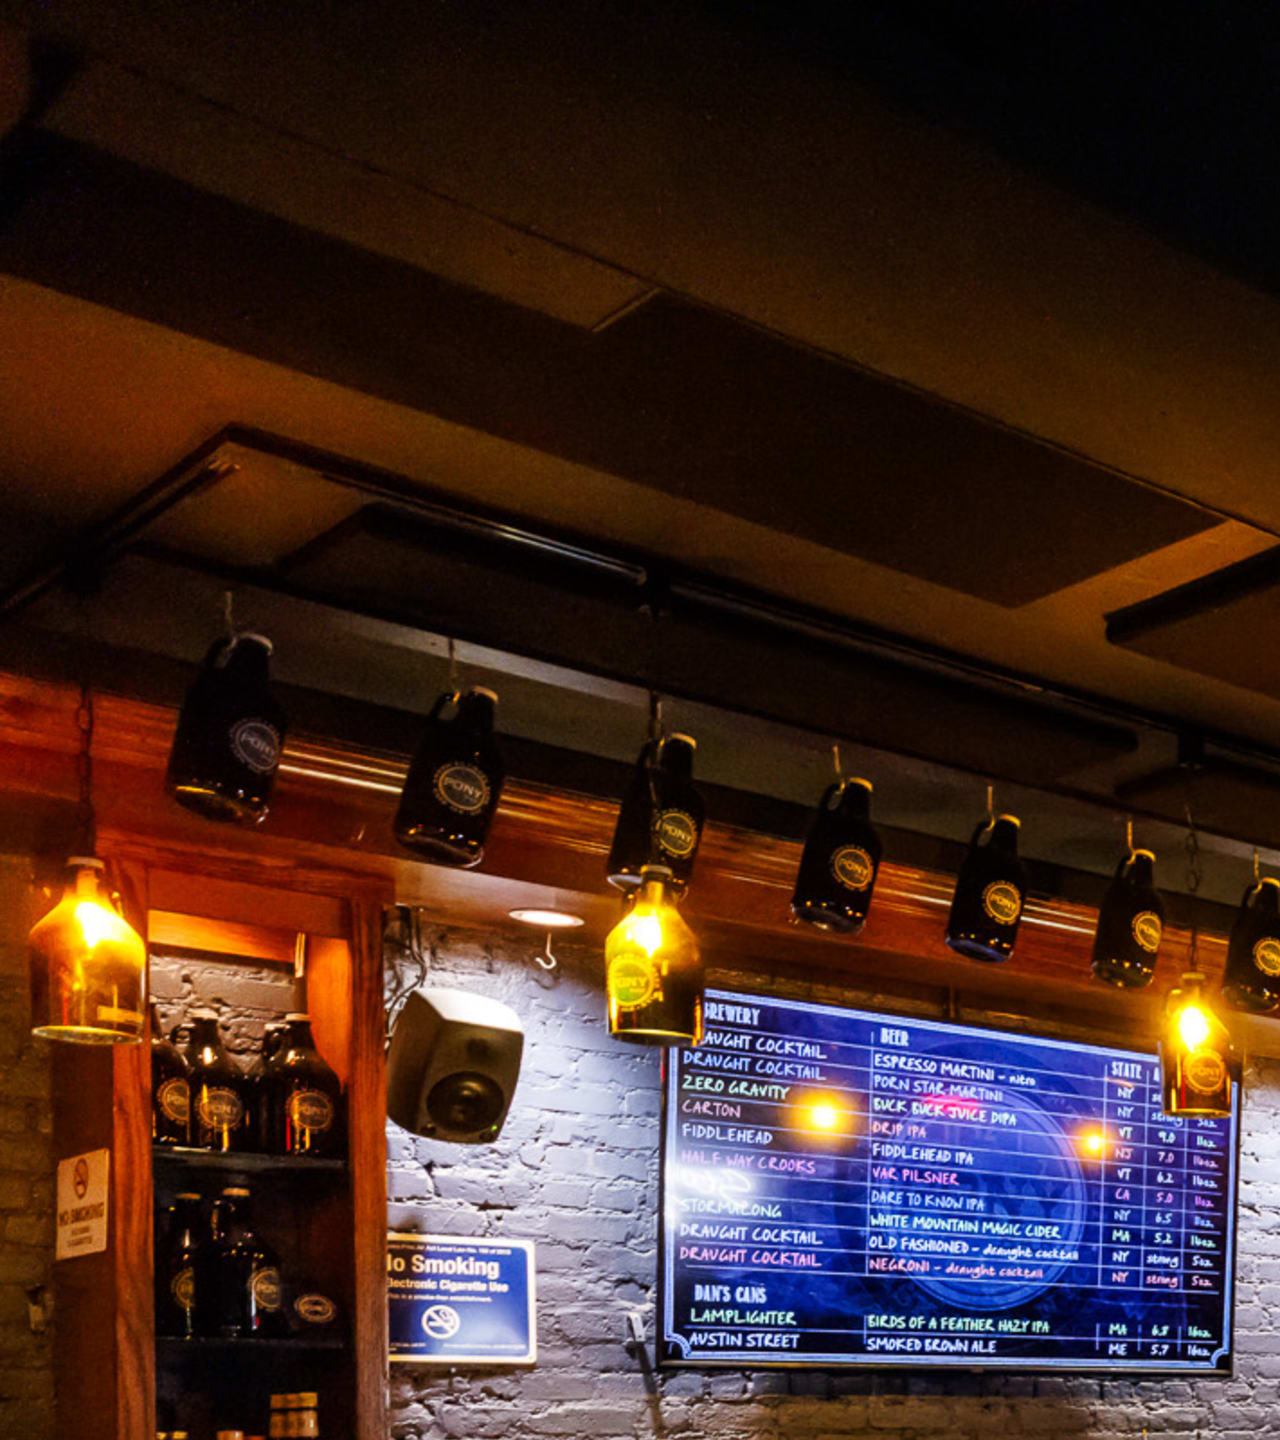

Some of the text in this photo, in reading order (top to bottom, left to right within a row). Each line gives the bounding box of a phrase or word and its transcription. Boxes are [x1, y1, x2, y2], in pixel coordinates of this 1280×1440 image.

[443, 776, 481, 799] PONY
[663, 822, 693, 842] PONY
[838, 857, 869, 877] PONY
[704, 1002, 761, 1026] BREWERY
[703, 1031, 827, 1059] AUGHT COCKTAIL
[880, 1027, 910, 1047] BEER
[683, 1050, 827, 1081] DRAUGHT COCKTAIL
[874, 1053, 937, 1073] ESPRESSO
[941, 1062, 995, 1081] MARTINI
[1112, 1061, 1142, 1080] STATE
[682, 1075, 790, 1100] ZERO GRAVITY
[874, 1075, 1004, 1102] PORN STAR MARTINI
[1117, 1086, 1135, 1100] NY
[682, 1099, 741, 1119] CARTON
[874, 1098, 1016, 1126] BUCK BUCK JUICE DIPA
[1117, 1106, 1135, 1119] NY
[681, 1123, 773, 1145] FIDDLEHEAD
[872, 1121, 927, 1138] DRIP IPA
[1119, 1126, 1133, 1139] VT
[681, 1150, 816, 1174] HALF WAY CROOKS
[872, 1143, 974, 1165] FIDDLEHEAD IPA
[872, 1167, 959, 1186] VAR PILSNER
[1117, 1169, 1131, 1181] VT
[871, 1190, 985, 1211] DARE TO KNOW IPA
[1115, 1188, 1130, 1201] CA
[1114, 1210, 1131, 1222] NY
[680, 1224, 823, 1246] DRAUGHT COCKTAIL
[870, 1216, 1061, 1239] WHITE MOUNTAIN MAGIC CIDER
[1112, 1230, 1131, 1243] MA
[680, 1247, 822, 1268] DRAUGHT COCKTAIL
[869, 1236, 1079, 1261] OLD FASHIONED draught cocktail
[1112, 1251, 1130, 1264] NY
[411, 1254, 499, 1279] Smoking
[869, 1258, 1043, 1279] NEGRONI draught cocktail
[1146, 1255, 1179, 1268] strong
[440, 1280, 487, 1292] Cigarette
[489, 1281, 509, 1292] Use
[1112, 1272, 1129, 1283] NY
[1146, 1275, 1179, 1288] strong
[694, 1284, 767, 1304] DAN'S CANS
[690, 1308, 797, 1326] LAMPLIGHTER
[868, 1315, 1051, 1333] BIRDS OF A FEATHER HAZY IPA
[1108, 1323, 1128, 1336] MA
[689, 1332, 800, 1349] AUSTIN STREET
[867, 1338, 997, 1353] SMOKED BROWN ALE
[1108, 1344, 1128, 1355] ME
